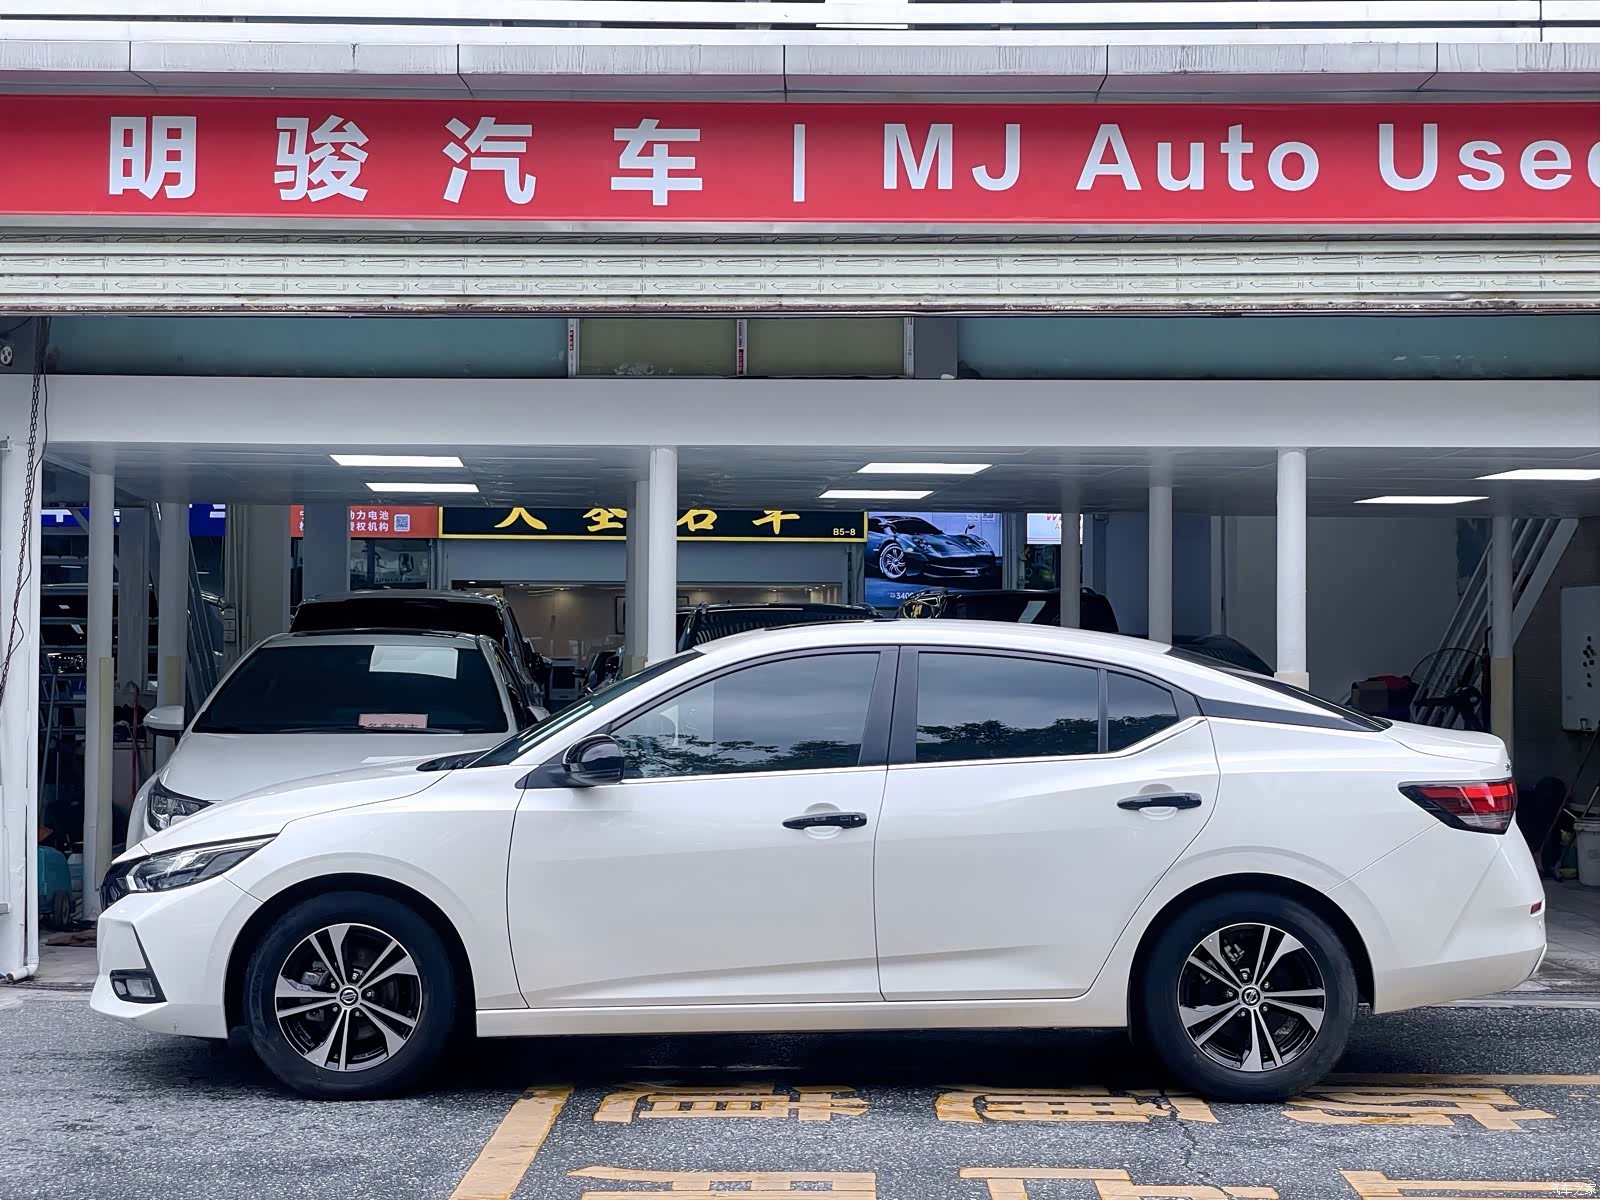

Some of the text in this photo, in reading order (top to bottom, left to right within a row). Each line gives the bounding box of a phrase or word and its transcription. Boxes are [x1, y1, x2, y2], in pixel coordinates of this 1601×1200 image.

[109, 115, 703, 206] 明骏汽车
[883, 124, 1021, 192] MJ
[1076, 124, 1321, 192] Auto
[1379, 123, 1600, 192] Use
[833, 528, 856, 536] B5-8
